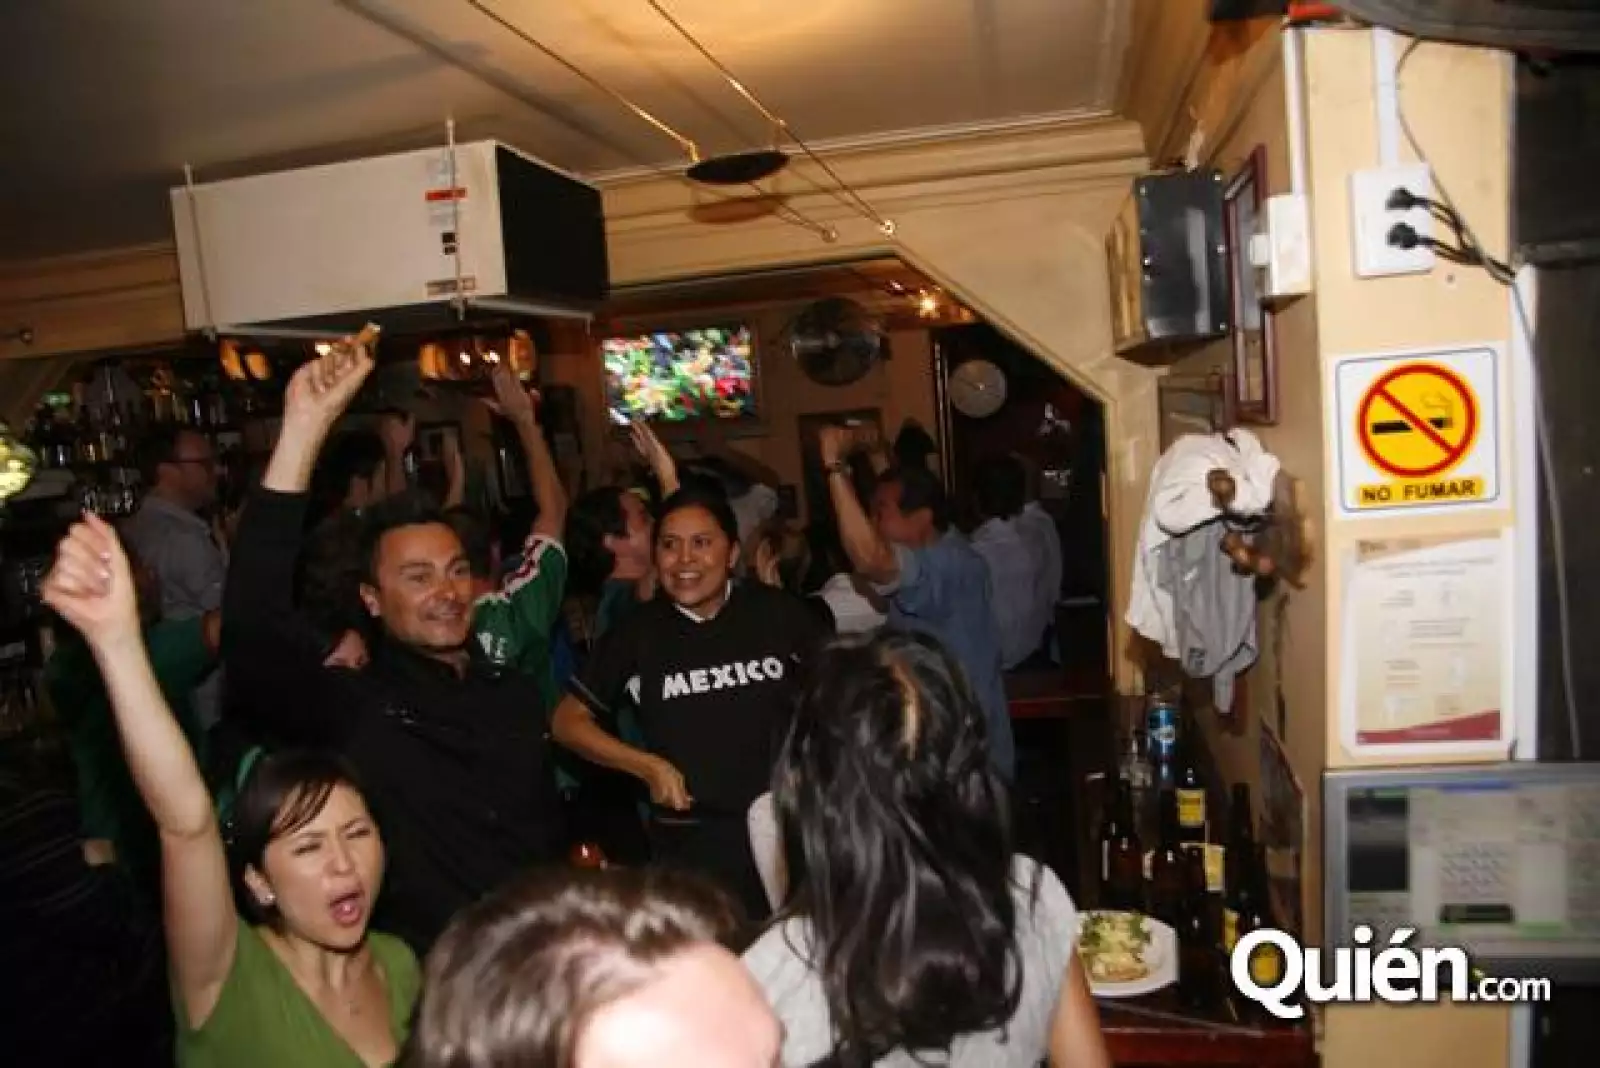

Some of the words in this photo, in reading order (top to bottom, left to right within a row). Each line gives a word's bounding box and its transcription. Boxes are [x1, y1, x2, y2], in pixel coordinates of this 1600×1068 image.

[1361, 486, 1391, 502] NO
[1403, 480, 1476, 500] FUMAR
[662, 655, 784, 700] MEXICO
